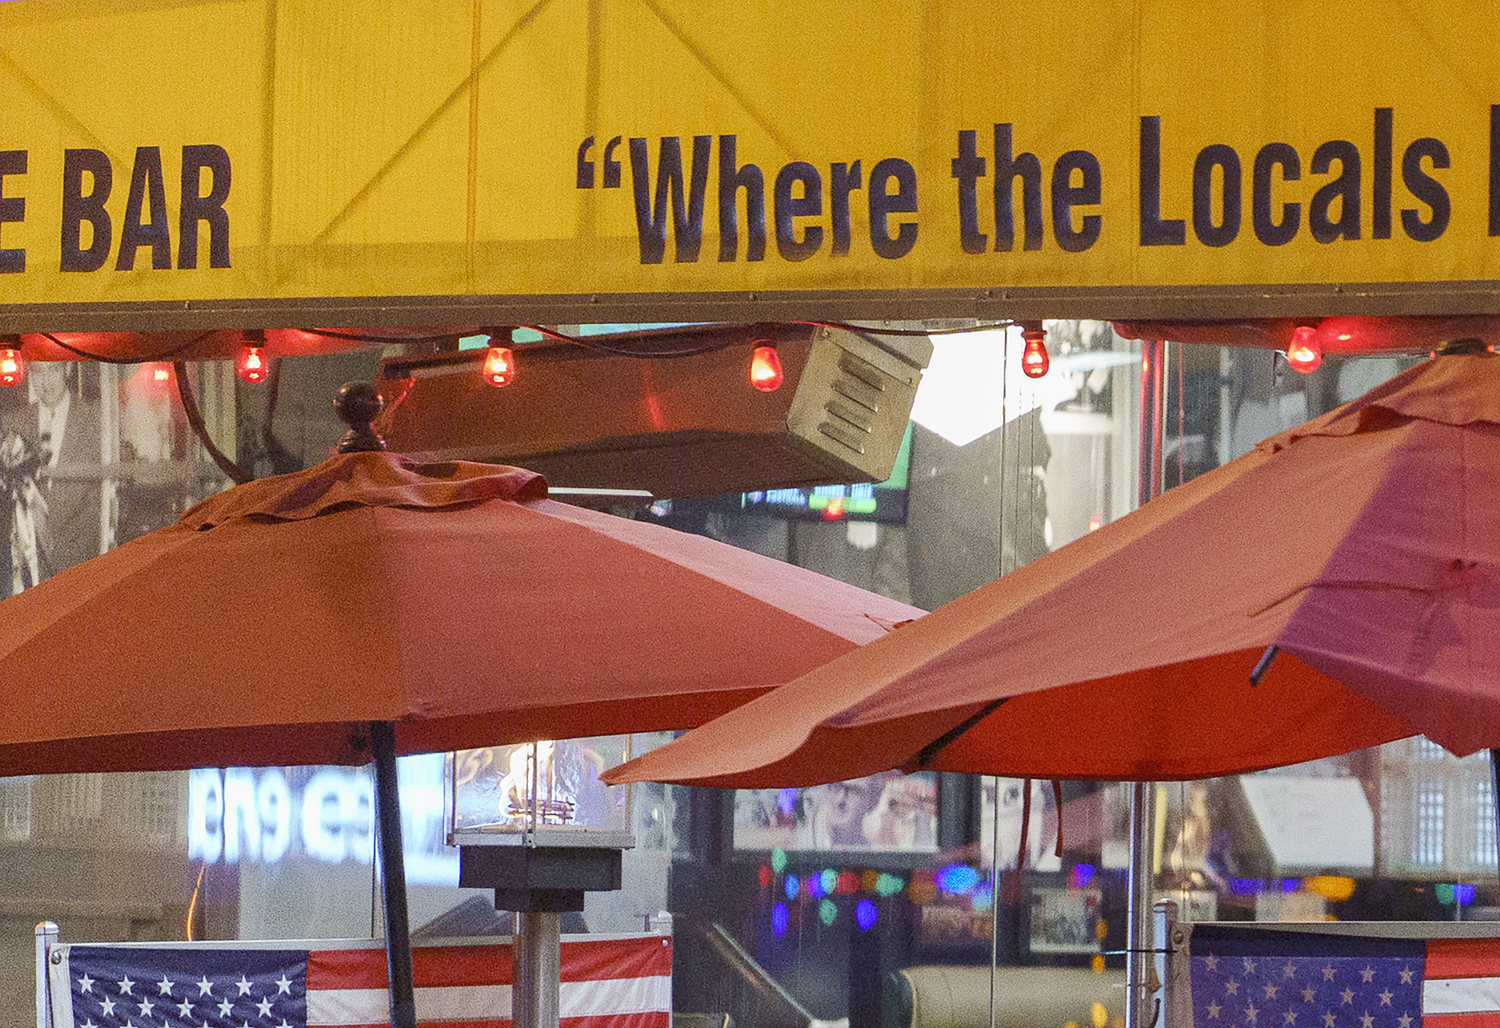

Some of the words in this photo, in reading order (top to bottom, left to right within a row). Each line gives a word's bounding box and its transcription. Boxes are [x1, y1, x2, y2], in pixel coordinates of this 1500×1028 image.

[60, 144, 232, 272] BAR
[576, 134, 918, 264] “Where
[951, 123, 1102, 254] the
[1139, 107, 1451, 248] Locals
